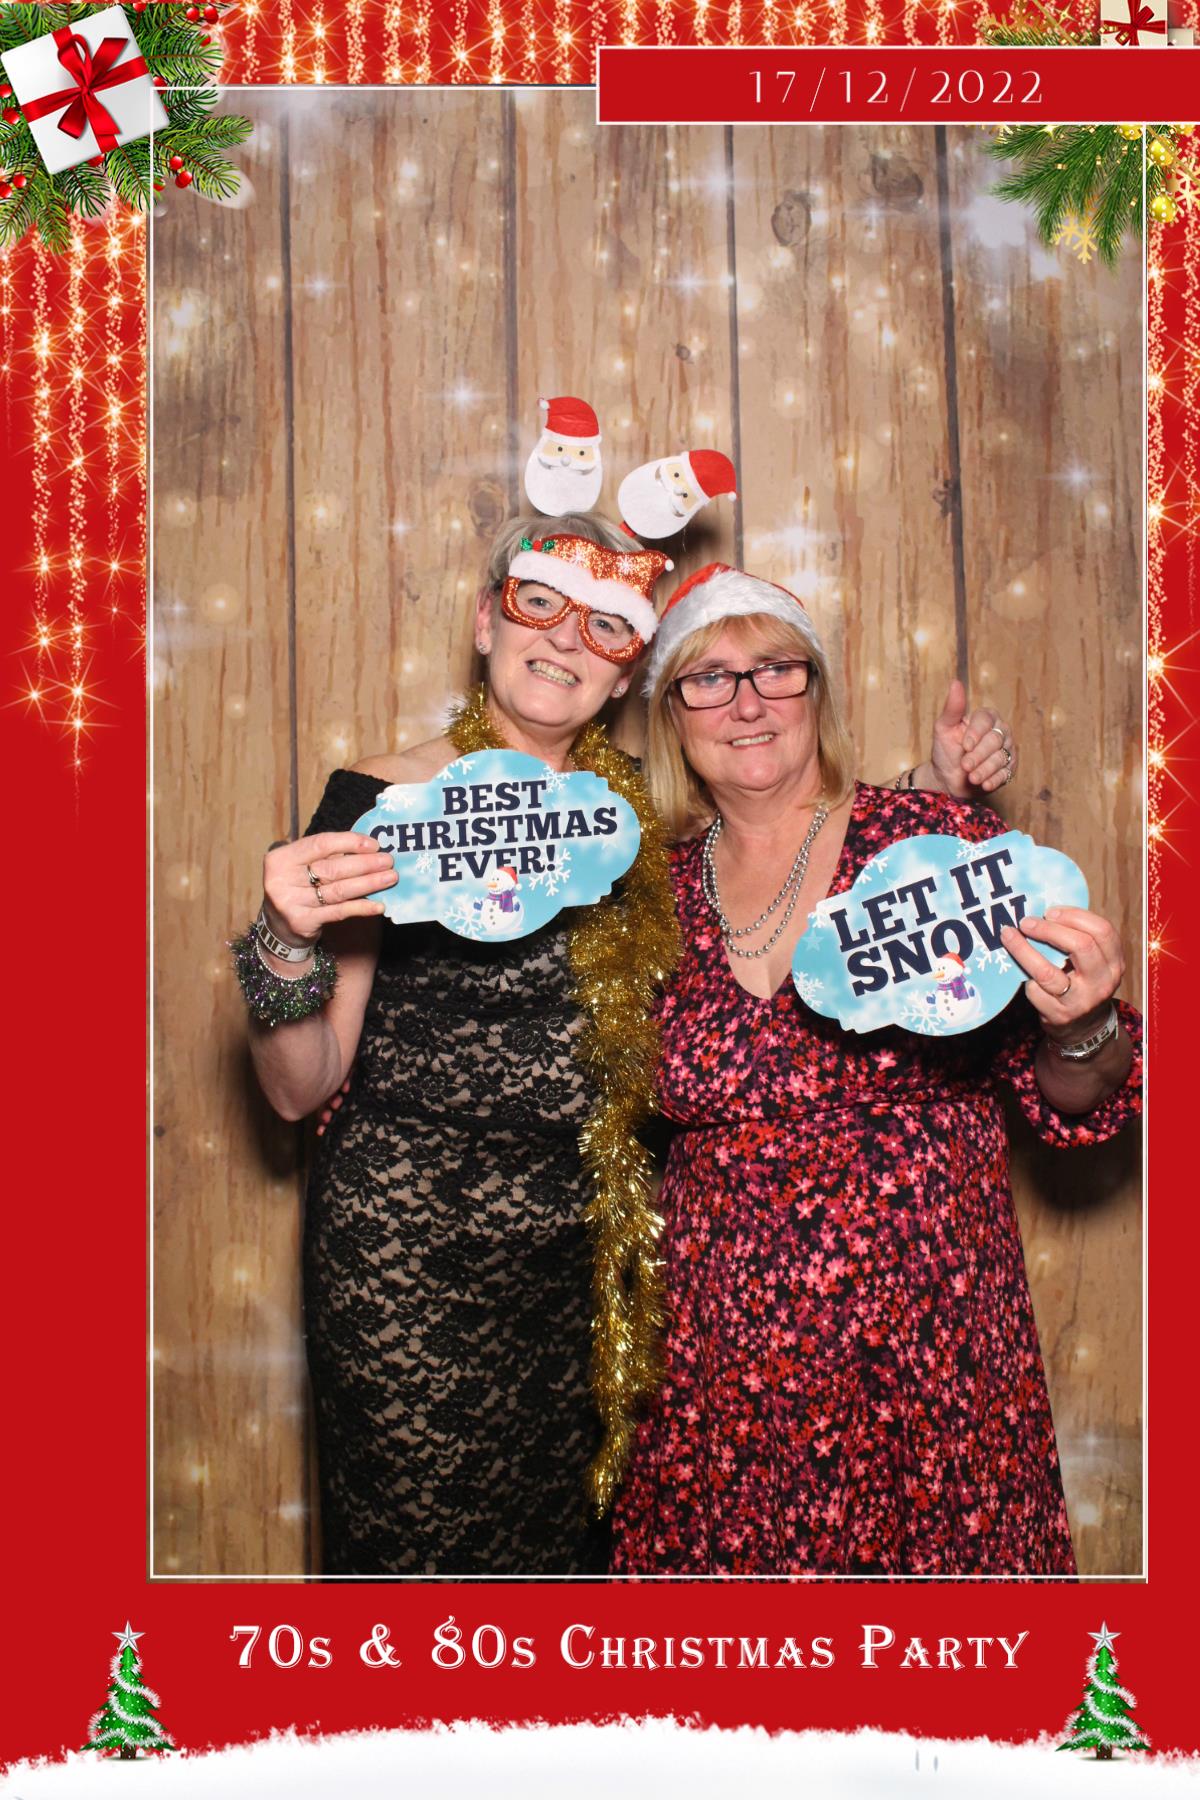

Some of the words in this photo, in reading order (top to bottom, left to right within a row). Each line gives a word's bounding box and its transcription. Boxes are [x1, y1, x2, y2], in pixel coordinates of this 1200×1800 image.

[442, 780, 547, 815] BEST
[369, 807, 618, 854] CHRISTMAS
[438, 844, 556, 882] EVER!
[830, 876, 937, 952] LET
[949, 848, 1014, 909] IT
[847, 894, 1027, 997] SNOW
